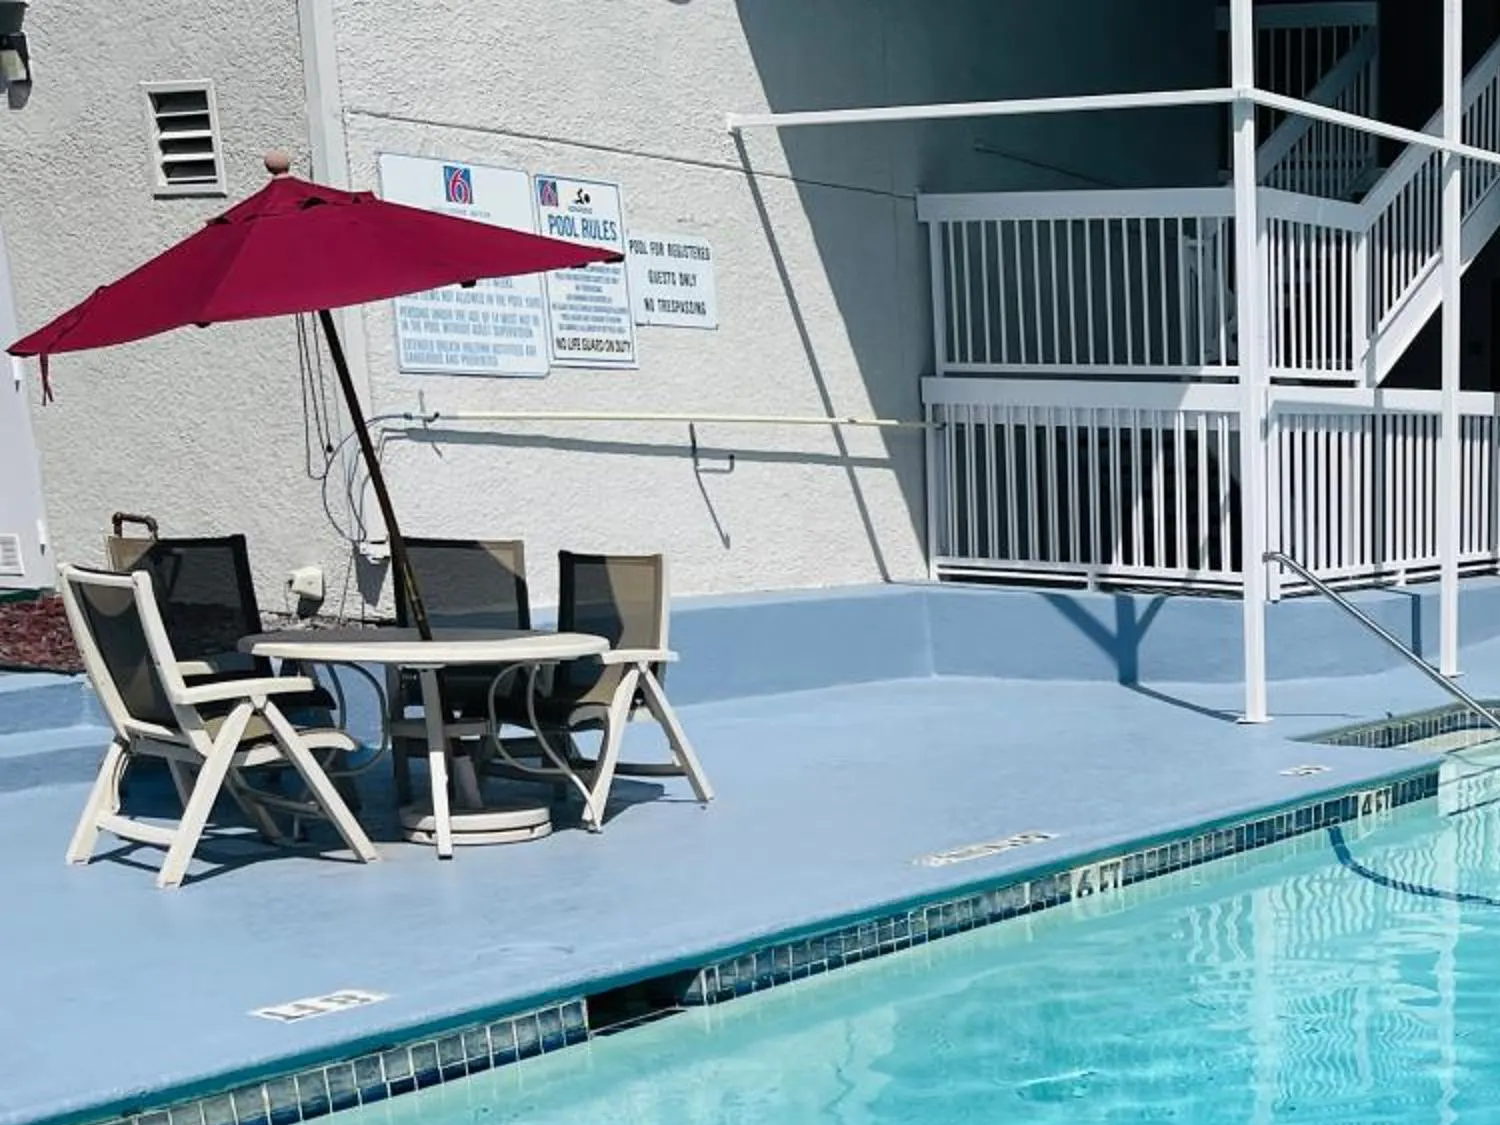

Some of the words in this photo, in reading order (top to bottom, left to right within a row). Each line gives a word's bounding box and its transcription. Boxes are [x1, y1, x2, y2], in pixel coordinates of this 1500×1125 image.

[449, 168, 471, 205] 6
[548, 214, 579, 237] POOL
[582, 219, 617, 241] RULES
[629, 239, 648, 255] POOL
[650, 240, 664, 256] FOR
[667, 243, 711, 260] REGISTERED
[647, 269, 676, 285] GUESTS
[679, 272, 697, 287] ONLY
[643, 298, 655, 312] NO
[657, 299, 707, 315] TRESPASSING
[556, 337, 566, 350] NO
[568, 337, 581, 351] LIFE
[582, 337, 604, 352] GUARD
[605, 339, 615, 352] ON
[616, 340, 632, 353] DUTY
[1361, 793, 1372, 816] 4
